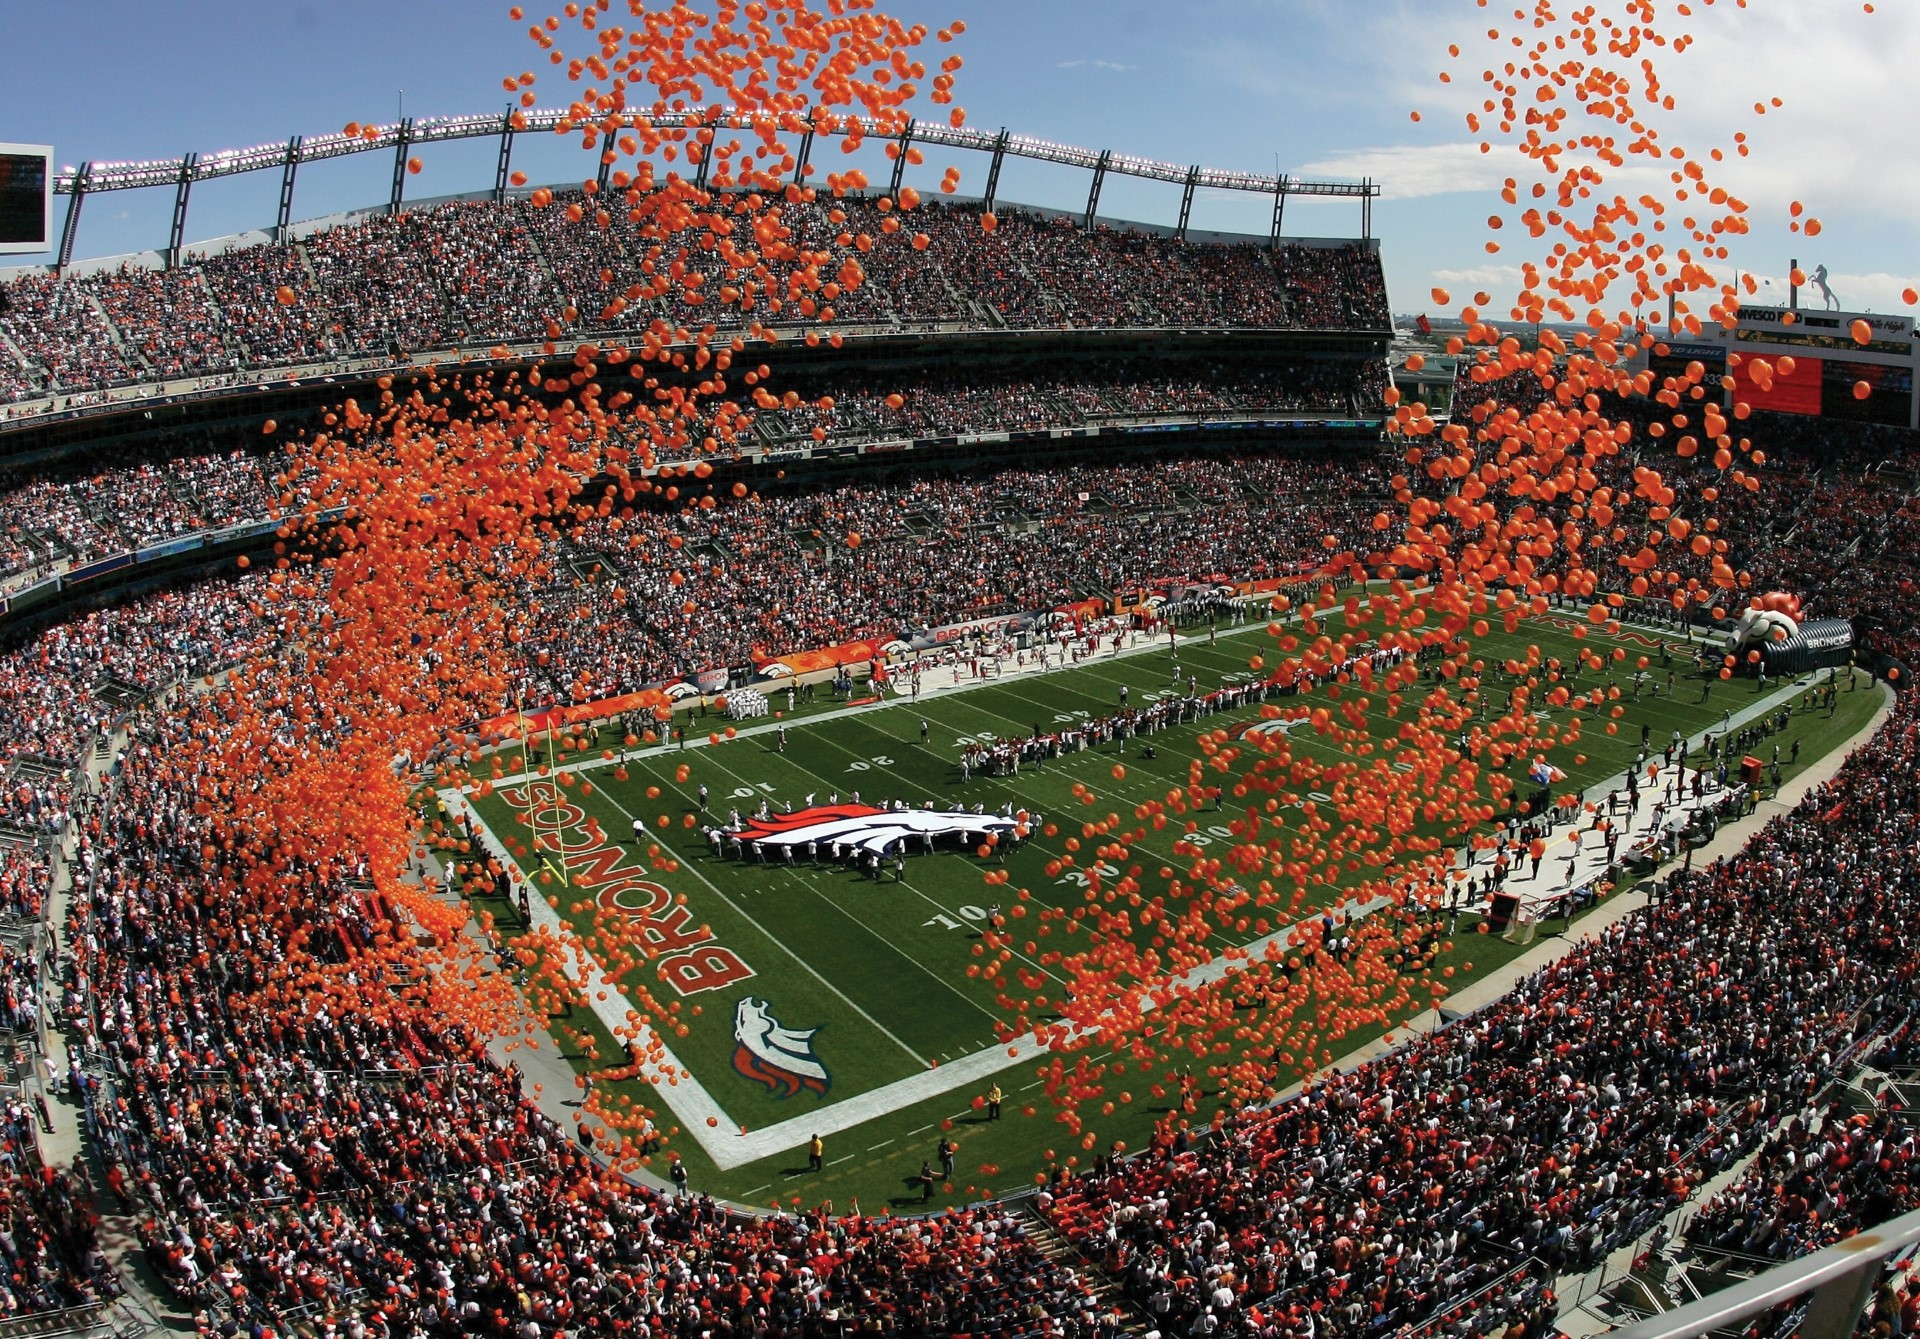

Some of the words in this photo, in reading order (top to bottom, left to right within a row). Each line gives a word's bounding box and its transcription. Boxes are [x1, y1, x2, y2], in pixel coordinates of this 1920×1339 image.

[1737, 308, 1776, 322] INVESCO
[1687, 347, 1722, 356] LIGHT
[1807, 632, 1851, 649] BRONCOS
[850, 755, 895, 773] 20
[1065, 863, 1121, 888] 20
[498, 781, 758, 998] BRONCOS
[934, 904, 987, 932] 10
